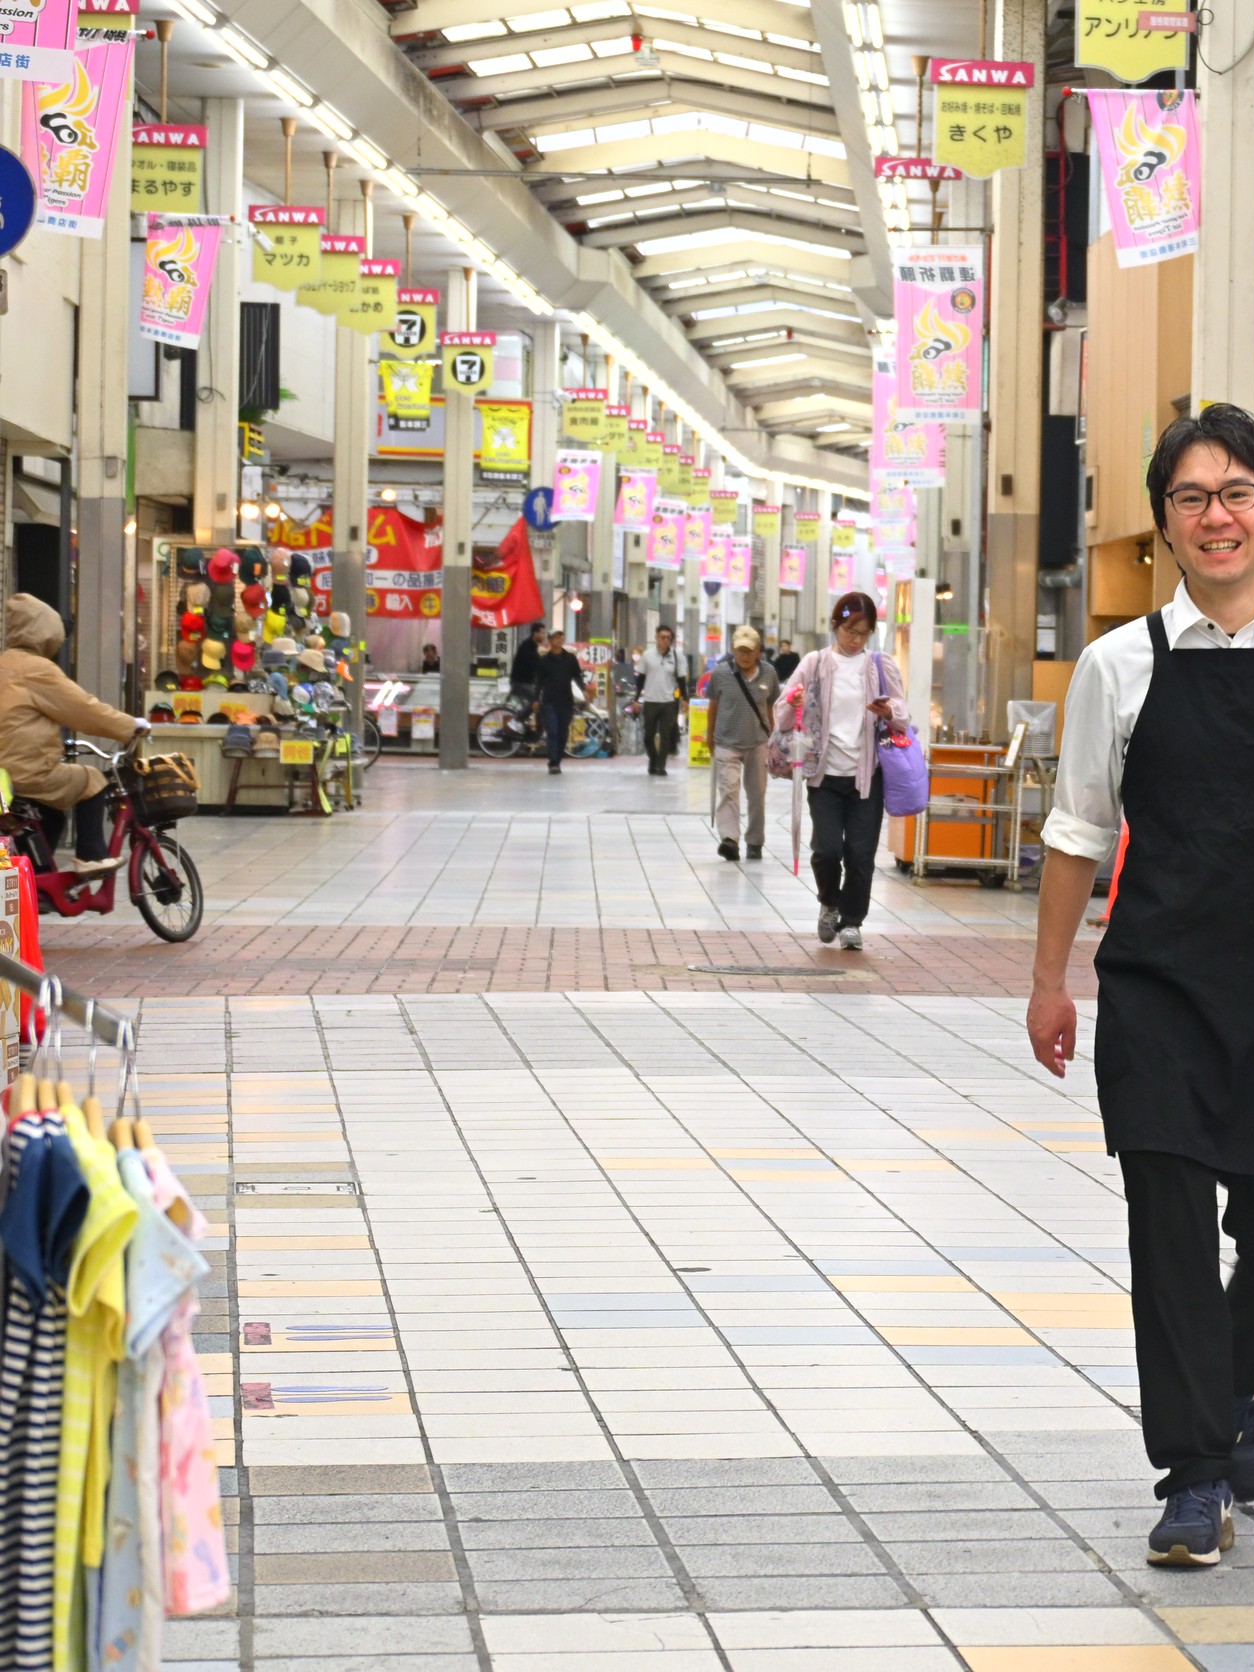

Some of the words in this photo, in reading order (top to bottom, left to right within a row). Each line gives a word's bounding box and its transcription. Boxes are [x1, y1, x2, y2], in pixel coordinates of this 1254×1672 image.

[0, 7, 33, 18] ssion
[1085, 16, 1178, 39] アンリ
[939, 62, 1026, 84] SANWA
[131, 130, 199, 145] ANWA
[949, 124, 1012, 143] きくや
[881, 160, 955, 177] SANWA
[253, 207, 318, 222] SANWA
[444, 334, 491, 344] SANWA
